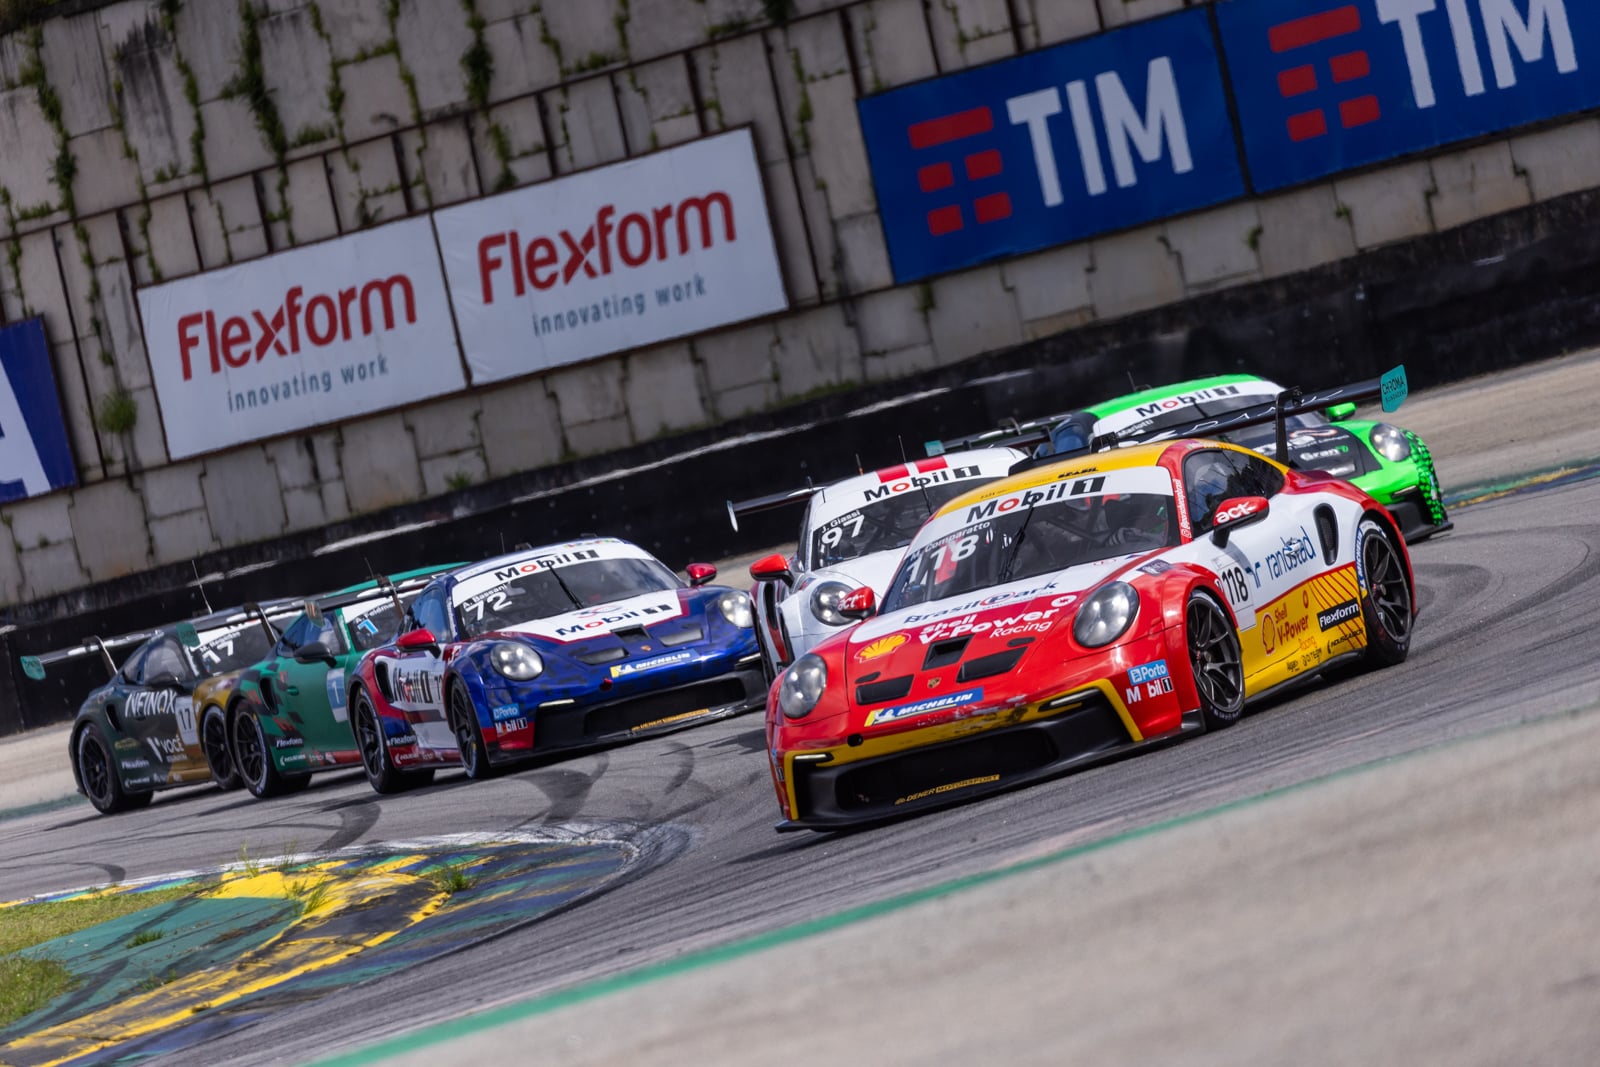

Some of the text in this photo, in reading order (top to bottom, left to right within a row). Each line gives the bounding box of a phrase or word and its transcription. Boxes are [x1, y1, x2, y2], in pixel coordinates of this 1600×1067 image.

[1376, 0, 1578, 109] TIM
[1006, 56, 1194, 207] TIM
[478, 191, 736, 304] Flexform
[533, 273, 706, 337] innovating work
[177, 274, 417, 381] Flexform
[228, 354, 388, 413] innovating work
[1136, 391, 1211, 417] Mobil
[864, 465, 982, 502] Mobil 1
[966, 482, 1068, 523] Mobil
[1070, 476, 1106, 496] 1
[821, 514, 865, 549] 97
[830, 509, 861, 529] Giassi
[494, 549, 600, 581] Mobil 1
[906, 534, 980, 586] 118
[1222, 567, 1249, 605] 118
[464, 591, 513, 621] 72
[1275, 602, 1288, 624] Shell
[1319, 602, 1359, 628] Flexform
[555, 611, 640, 636] Mobil
[918, 608, 1060, 645] V-Power
[920, 614, 978, 634] Shell
[989, 621, 1054, 638] Racing
[1277, 614, 1309, 646] V-Power
[635, 652, 691, 670] MICHELIN
[1140, 663, 1167, 680] Porto
[897, 693, 974, 716] MICHELIN
[1126, 676, 1174, 705] Mbil 1
[178, 707, 192, 731] 17
